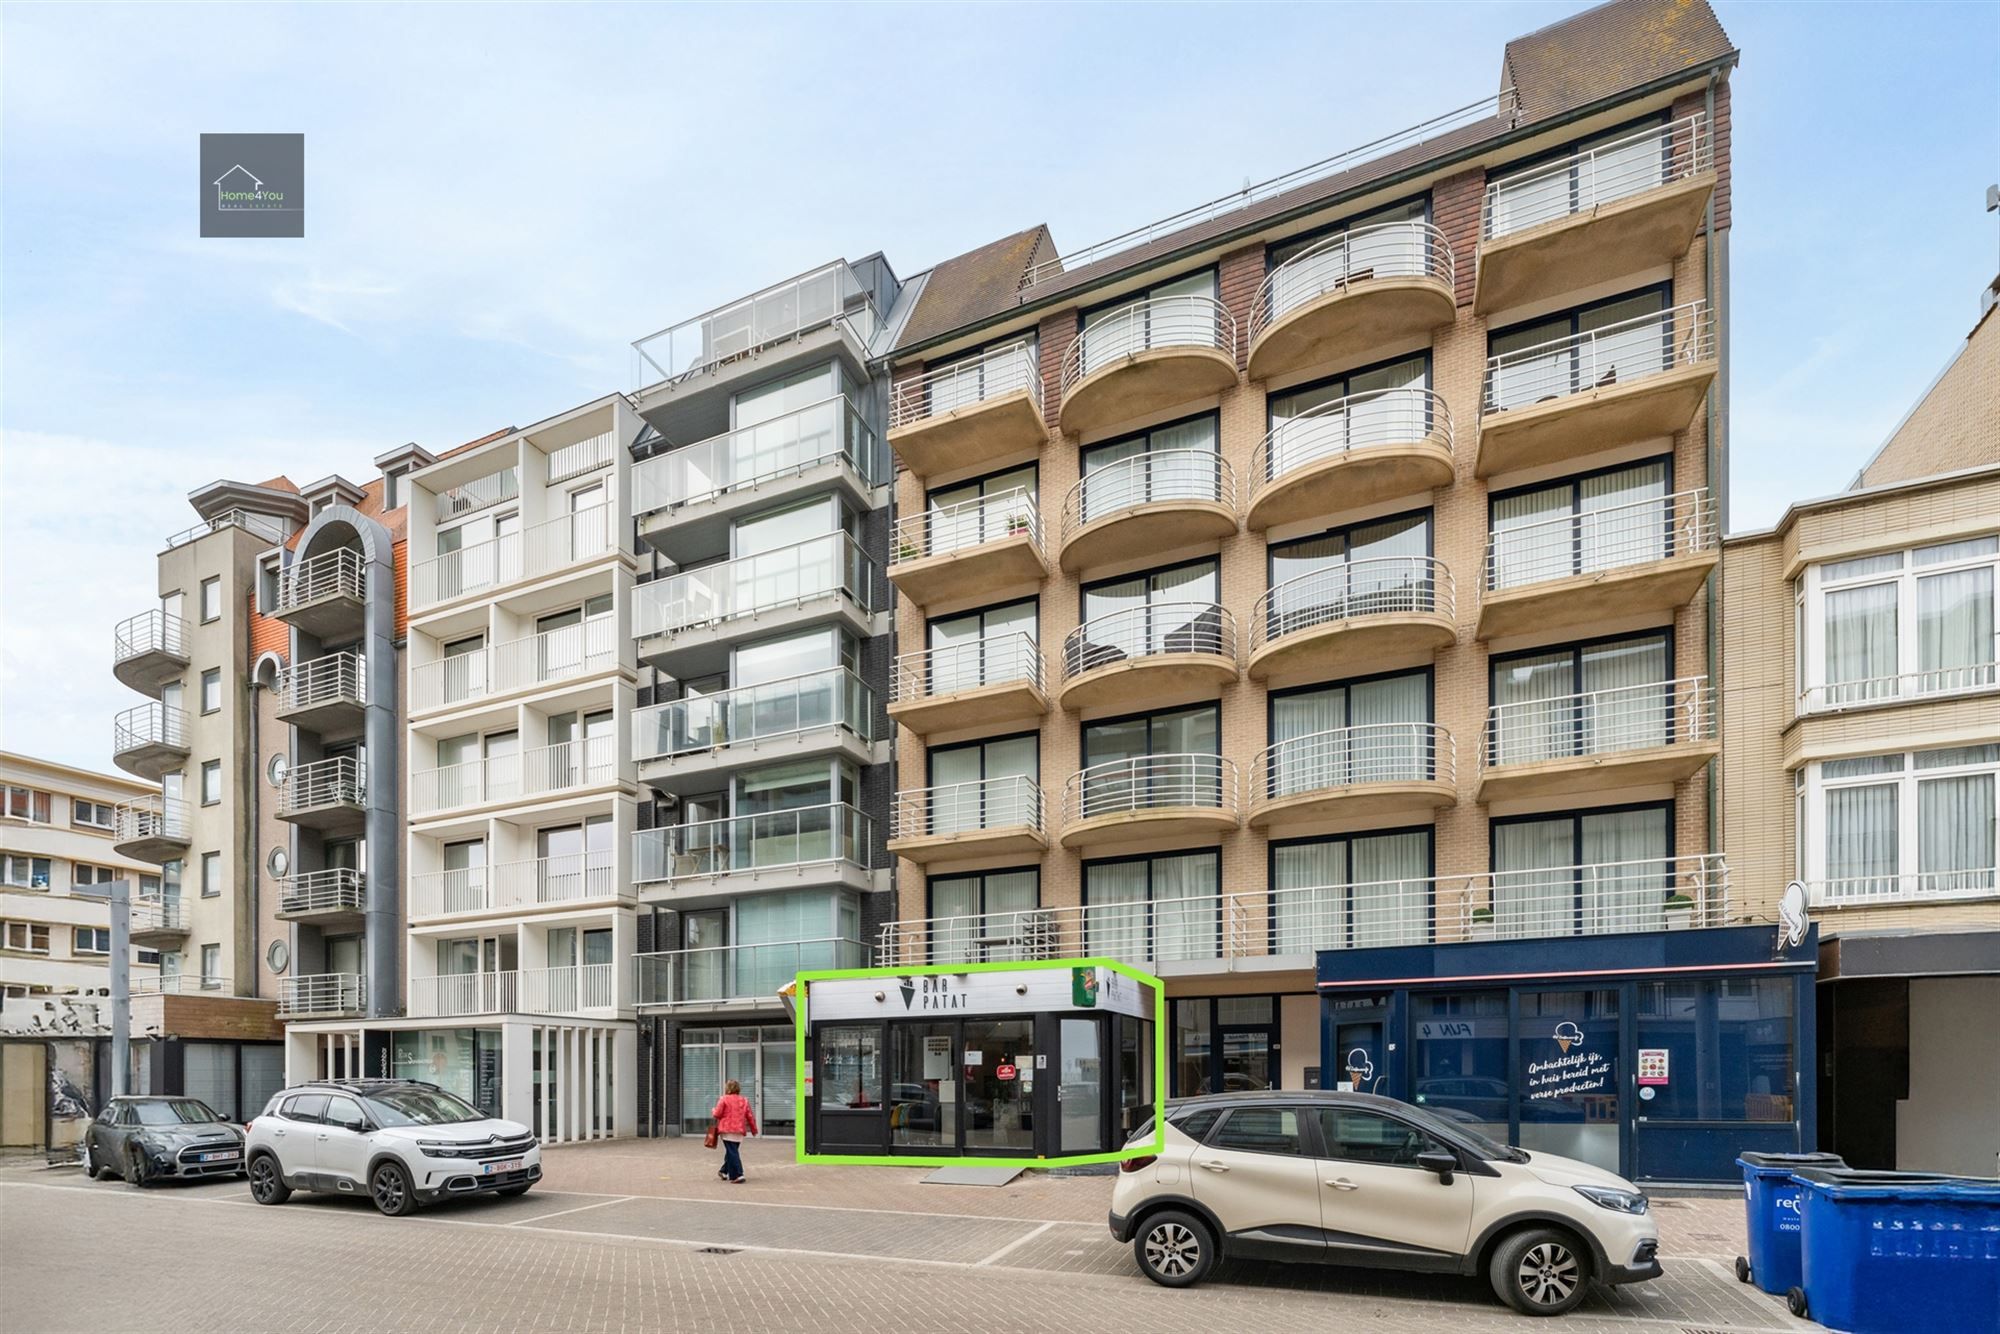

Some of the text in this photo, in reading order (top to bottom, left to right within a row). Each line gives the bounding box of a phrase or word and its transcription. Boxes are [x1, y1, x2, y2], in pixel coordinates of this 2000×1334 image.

[923, 978, 947, 993] BAR
[923, 993, 967, 1009] PATAT
[1528, 1052, 1603, 1074] Ambachtelijk ijs,
[1529, 1063, 1611, 1086] in huis bereid met
[1530, 1076, 1604, 1100] verse producten!
[1780, 1223, 1800, 1231] 0800
